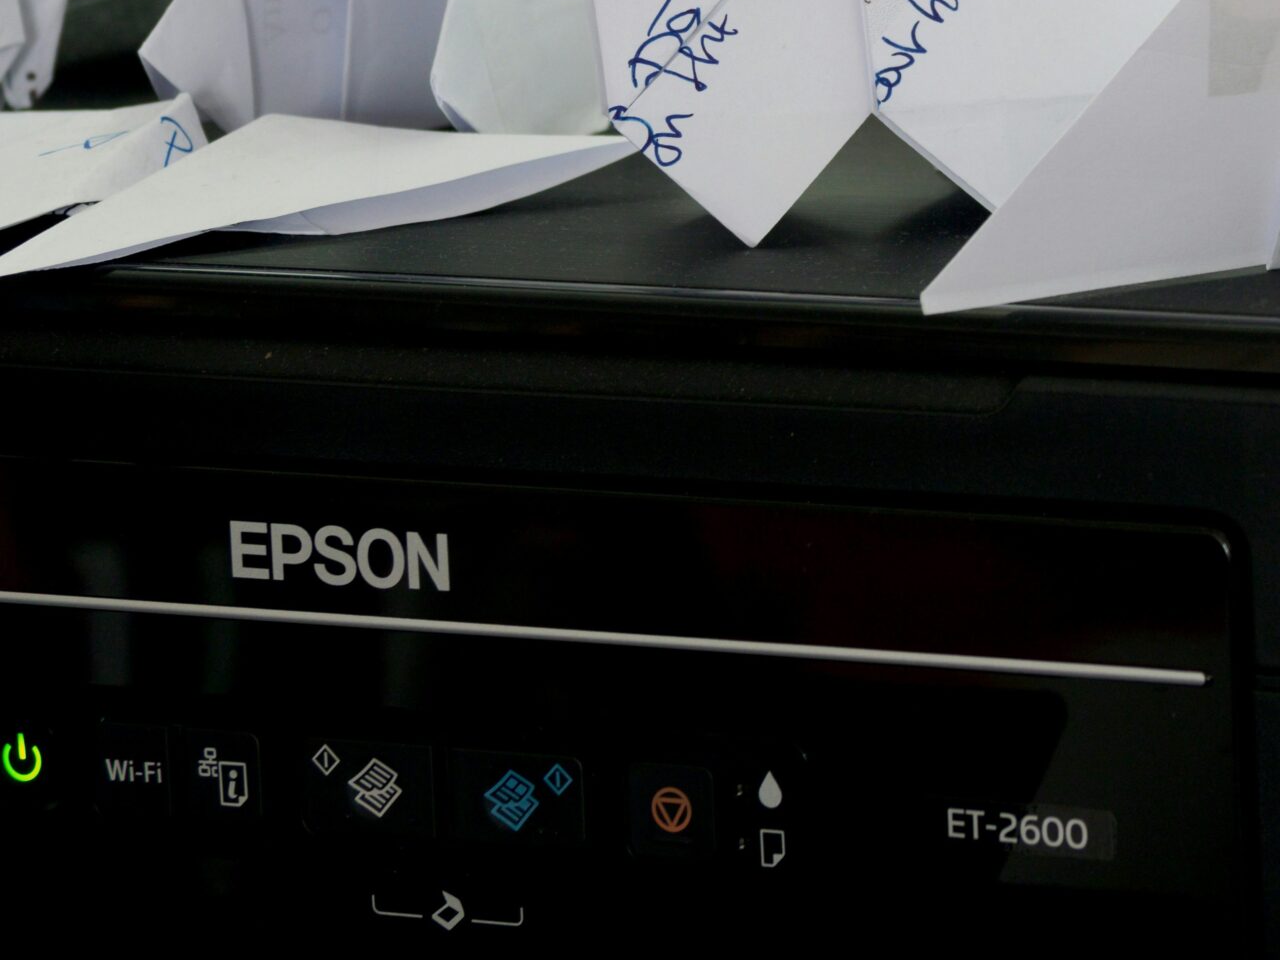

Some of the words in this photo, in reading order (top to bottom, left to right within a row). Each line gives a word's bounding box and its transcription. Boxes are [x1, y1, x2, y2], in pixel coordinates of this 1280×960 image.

[229, 520, 451, 592] EPSON
[105, 758, 163, 784] Wi-Fi
[947, 807, 1088, 850] ET-2600
